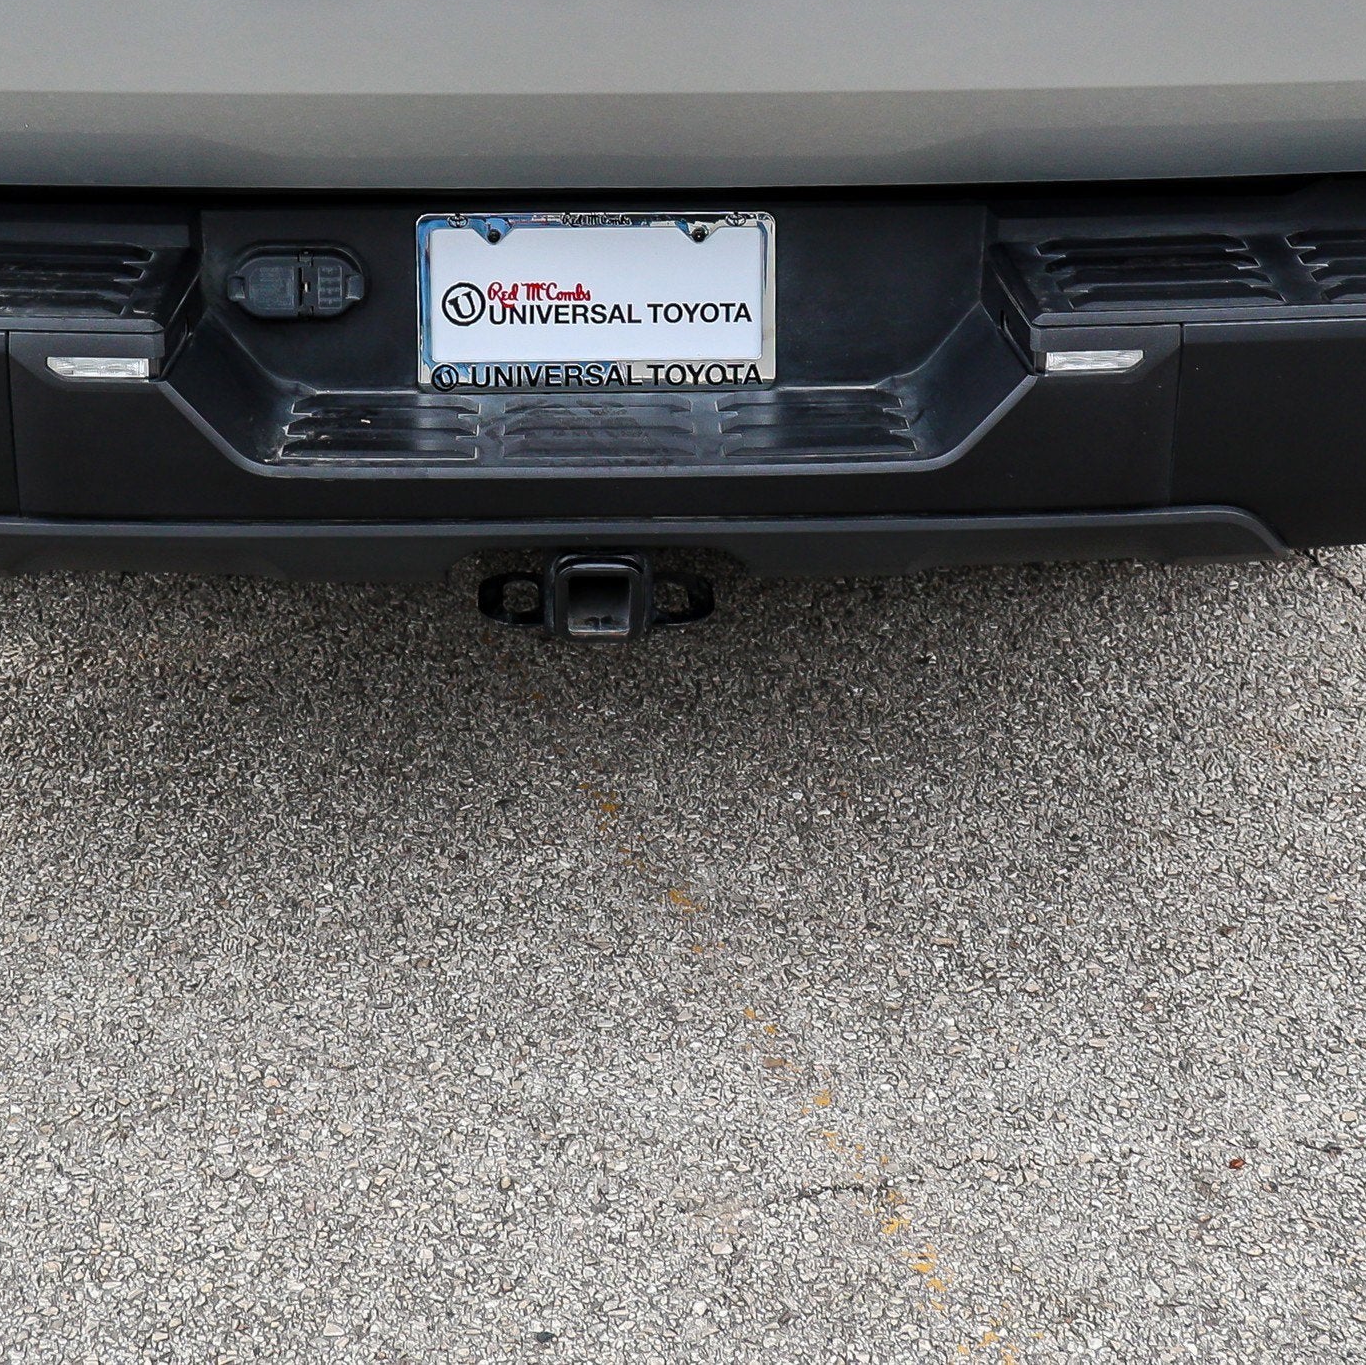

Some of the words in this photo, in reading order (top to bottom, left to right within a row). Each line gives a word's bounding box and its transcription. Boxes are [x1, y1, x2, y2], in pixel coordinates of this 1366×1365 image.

[561, 213, 584, 227] Red
[487, 282, 519, 308] Red
[521, 282, 591, 302] McCombs
[489, 302, 642, 325] UNIVERSAL
[647, 301, 753, 324] TOYOTA
[470, 364, 644, 387] UNIVERSAL
[647, 363, 764, 387] TOYOTA
